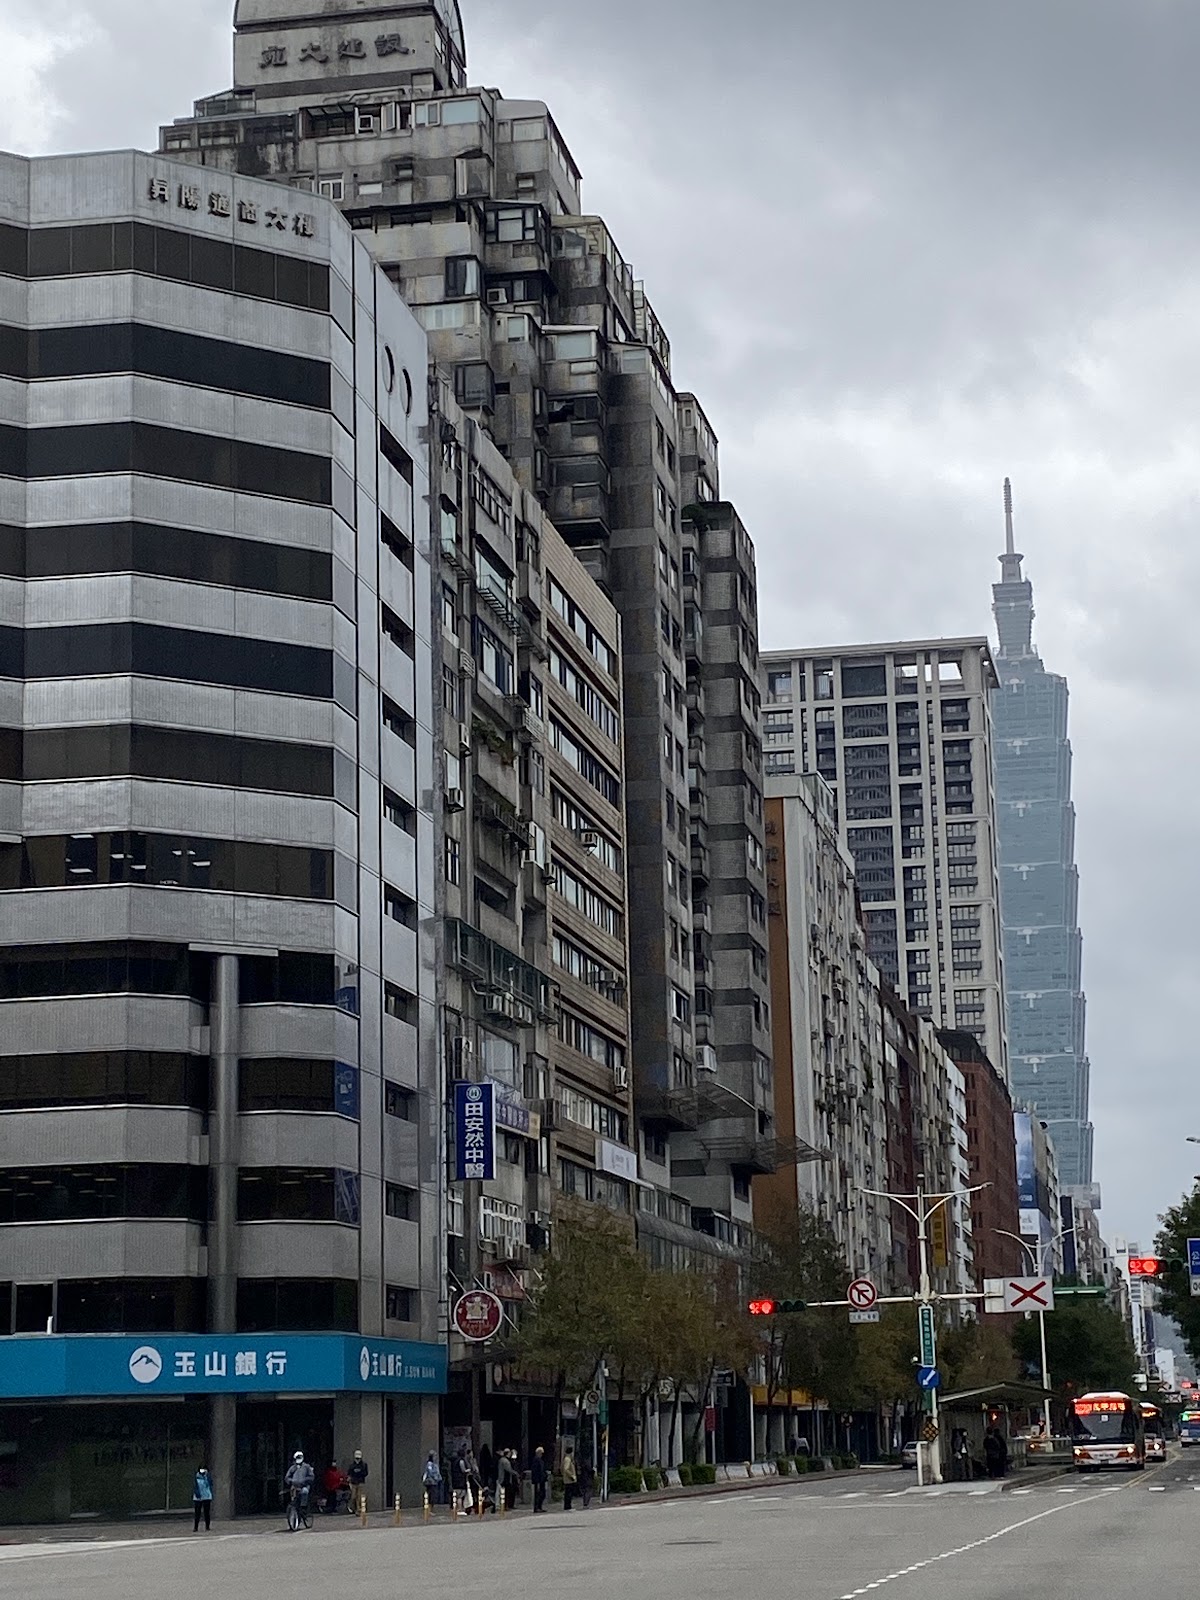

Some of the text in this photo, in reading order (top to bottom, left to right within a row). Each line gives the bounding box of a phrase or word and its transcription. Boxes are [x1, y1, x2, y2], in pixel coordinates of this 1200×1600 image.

[464, 1102, 485, 1178] 田安然中醫
[174, 1351, 287, 1377] 玉山銀行
[372, 1353, 402, 1376] 玉山銀行
